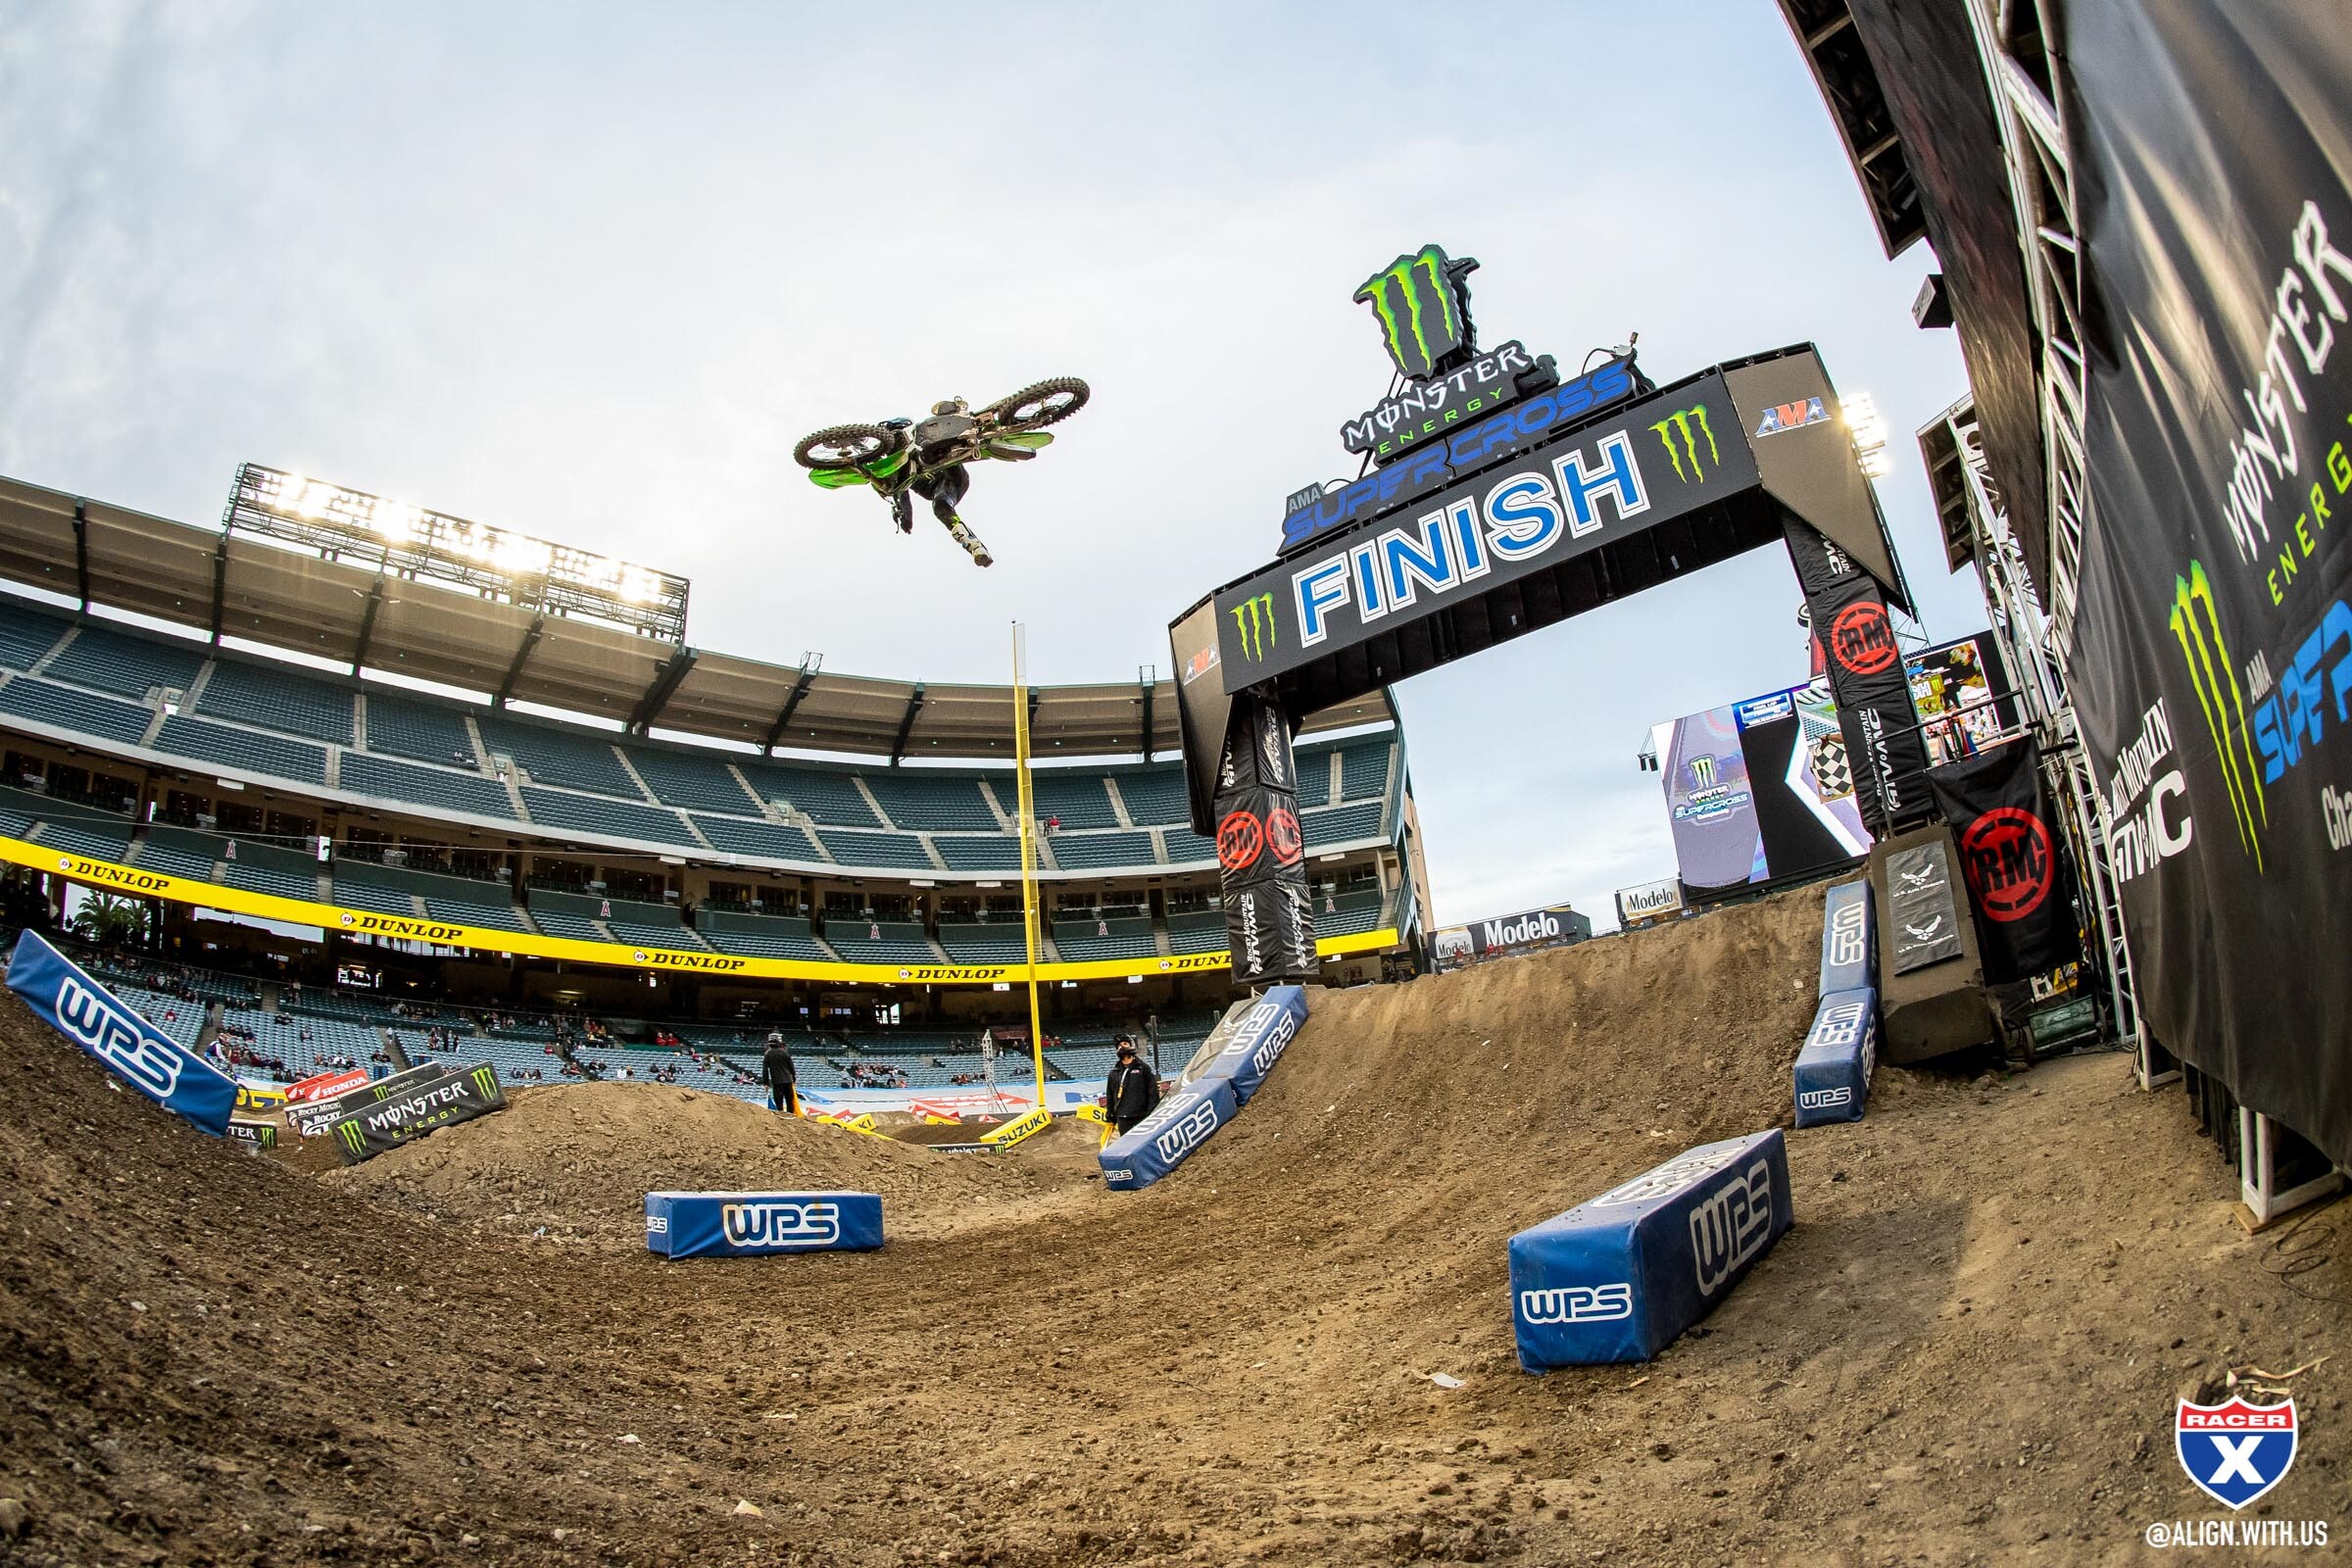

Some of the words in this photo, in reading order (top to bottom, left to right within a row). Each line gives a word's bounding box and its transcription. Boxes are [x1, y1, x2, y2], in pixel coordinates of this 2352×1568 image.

[1344, 345, 1529, 447] MONSTER
[1379, 387, 1503, 455] ENERGY
[1755, 397, 1832, 435] AMA
[1283, 361, 1632, 546] SUPERCROSS
[1288, 487, 1321, 514] AMA
[2268, 412, 2352, 607] ENERG
[1291, 429, 1651, 649] FINISH
[2246, 649, 2274, 705] AMA
[75, 861, 170, 891] DUNLOP
[1975, 825, 2043, 894] RM
[1241, 895, 1250, 936] MOUNTAIN
[1628, 888, 1673, 910] Modelo
[360, 916, 464, 940] DUNLOP
[1484, 912, 1560, 948] Modelo
[652, 954, 745, 970] DUNLOP
[1176, 955, 1231, 968] DUNL
[1438, 941, 1472, 957] Modelo
[916, 969, 1005, 979] DUNLOP
[56, 976, 183, 1097] WPS
[1223, 1004, 1280, 1055] WPS
[1253, 1010, 1296, 1077] WPS
[321, 1076, 367, 1097] HONDA
[1799, 1087, 1852, 1109] WPS
[297, 1106, 318, 1117] ROCKY
[314, 1110, 341, 1124] ROCKY
[368, 1081, 469, 1133] MONSTER
[392, 1105, 459, 1139] ENERGY
[998, 1112, 1048, 1145] SUZUKI
[1156, 1100, 1218, 1164] WPS
[1104, 1169, 1133, 1182] WPS
[723, 1203, 840, 1247] WPS
[1690, 1158, 1773, 1297] WPS
[1521, 1283, 1633, 1324] WPS
